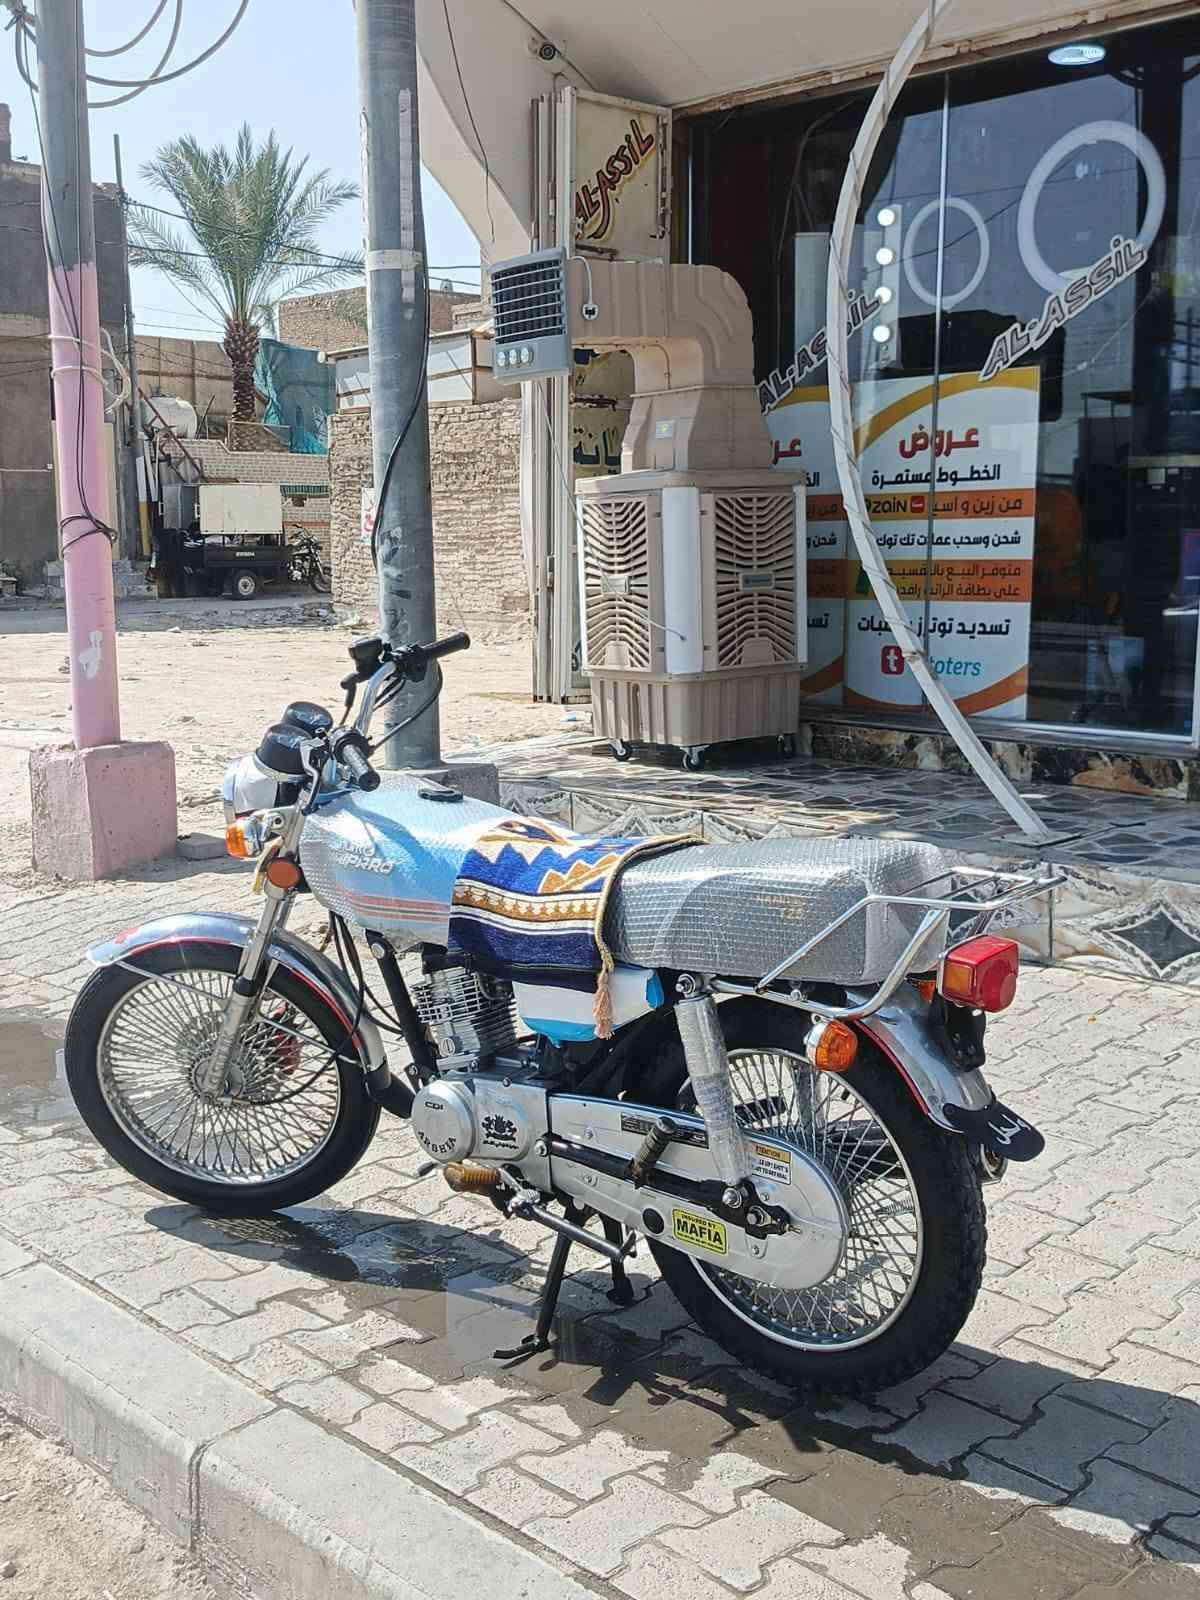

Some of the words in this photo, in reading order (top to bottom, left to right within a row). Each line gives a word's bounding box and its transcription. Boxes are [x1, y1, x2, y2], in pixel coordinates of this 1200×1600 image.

[898, 424, 980, 459] عروض
[871, 468, 932, 490] مستمرة
[936, 464, 1001, 486] الخطوط
[973, 496, 995, 516] زين
[998, 497, 1023, 513] من
[952, 535, 990, 549] وسحب
[991, 530, 1022, 548] شحن
[956, 618, 1011, 640] تسديد
[424, 1101, 444, 1111] CDI
[676, 1219, 723, 1246] MAFIA
